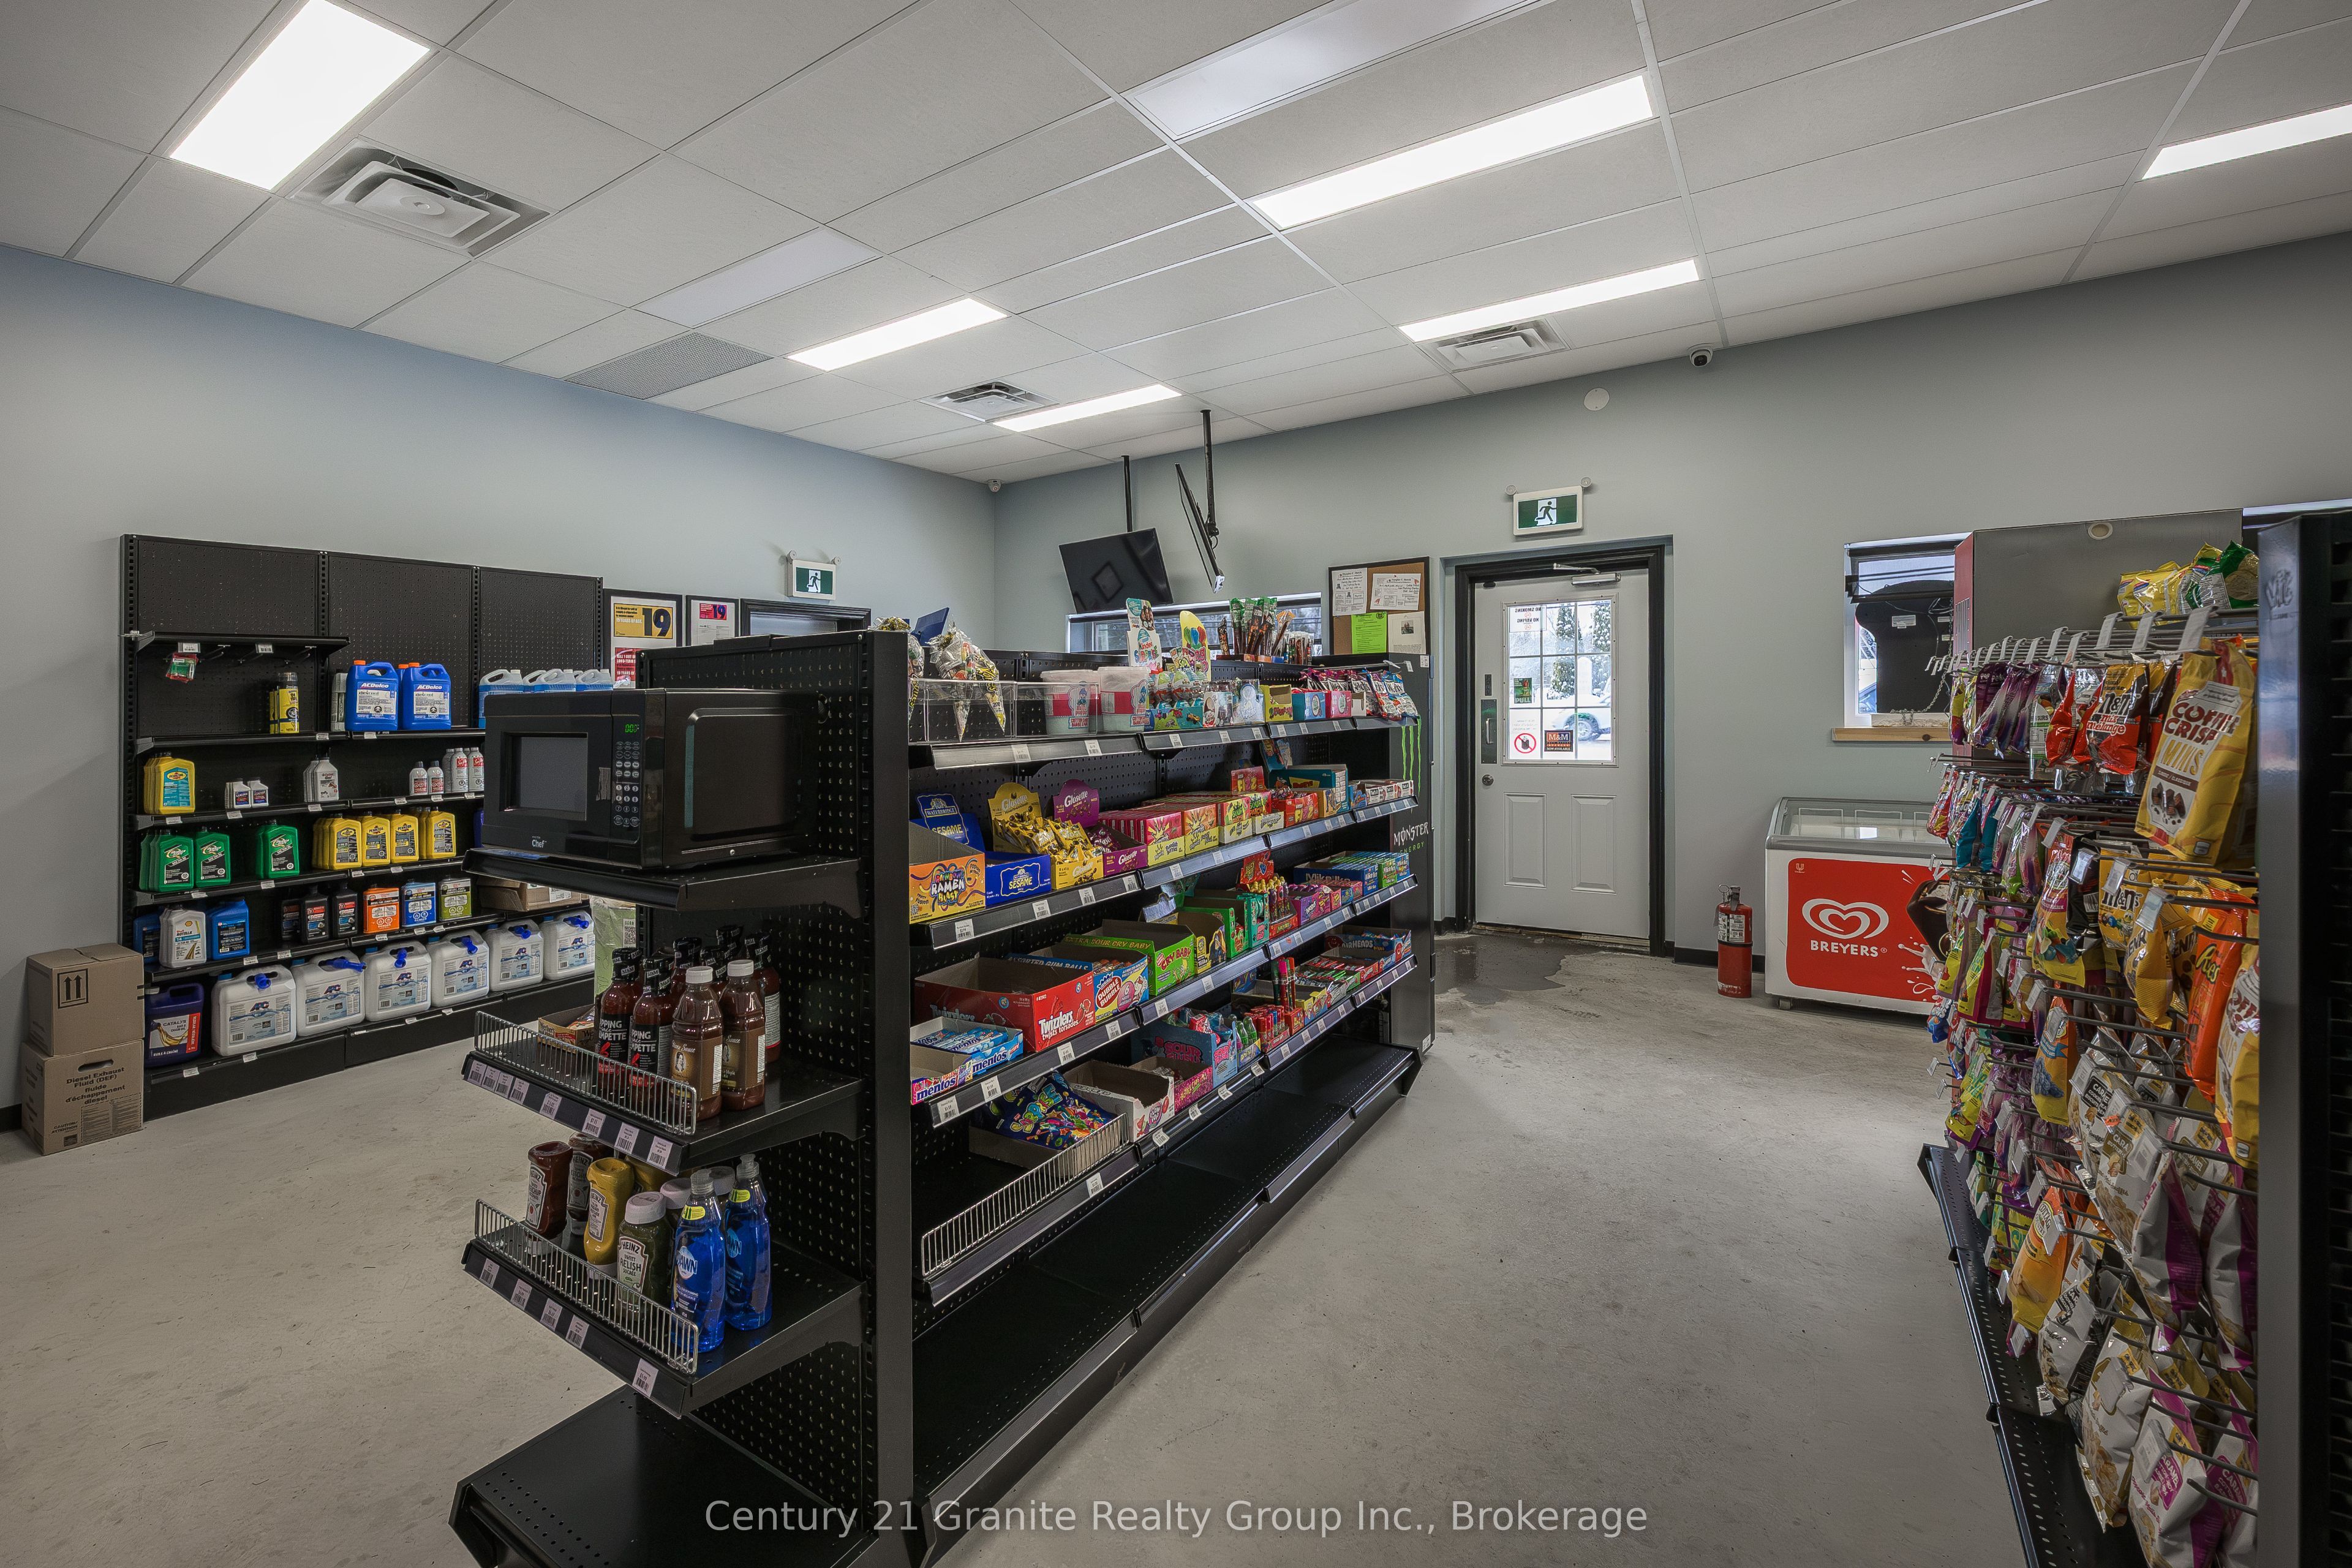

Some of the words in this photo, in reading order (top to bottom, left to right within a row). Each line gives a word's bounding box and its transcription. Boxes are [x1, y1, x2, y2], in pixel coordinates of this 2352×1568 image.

[712, 605, 726, 619] 19
[642, 608, 671, 637] 19
[1139, 641, 1153, 650] Kinder
[2165, 717, 2218, 745] CRISP
[1237, 775, 1257, 792] FIZZ
[1001, 794, 1028, 811] Glosette
[1064, 791, 1088, 807] Glosette
[927, 808, 956, 816] WATERBRIDGE
[1232, 807, 1243, 818] SOUR
[1250, 801, 1262, 812] SOUR
[1294, 804, 1314, 823] FIZZ
[932, 824, 963, 836] SESAME
[1393, 821, 1429, 846] MONSTER
[532, 839, 545, 848] Chef
[1400, 841, 1424, 854] ENERGY
[1118, 850, 1137, 865] Glosette
[935, 870, 962, 883] RAINBOW
[1009, 876, 1033, 890] SESAME
[931, 878, 965, 895] RAMEN
[938, 891, 959, 903] BLAST
[1810, 939, 1879, 959] BREYERS
[1161, 952, 1175, 971] CRY
[1175, 947, 1191, 959] BABY
[1097, 977, 1119, 1001] DUBBLE
[1100, 983, 1121, 1008] BUBBLE
[1125, 987, 1129, 995] 6
[1038, 1009, 1074, 1036] Twizzlers
[1042, 1028, 1058, 1041] twists
[1058, 1019, 1079, 1035] torsades
[726, 1035, 741, 1044] Sauce
[680, 1043, 696, 1053] Sauce
[1164, 1041, 1202, 1057] SOUR
[1213, 1045, 1229, 1057] SOUR
[972, 1049, 1008, 1073] mentos
[66, 1074, 91, 1084] Diesel
[92, 1067, 125, 1079] Exhaust
[74, 1079, 94, 1088] Fluid
[96, 1074, 118, 1084] (DEF)
[65, 1085, 126, 1103] d'échappement
[85, 1084, 107, 1093] fluide
[916, 1077, 956, 1101] mentos
[84, 1095, 108, 1105] diesel
[51, 1125, 78, 1134] ATTENTION
[530, 1168, 542, 1182] HEINZ
[591, 1193, 602, 1204] HEINZ
[621, 1240, 640, 1254] HEINZ
[726, 1232, 742, 1256] AWN
[624, 1253, 636, 1262] SWEET
[676, 1250, 698, 1275] DAWN
[620, 1258, 642, 1272] RELISH
